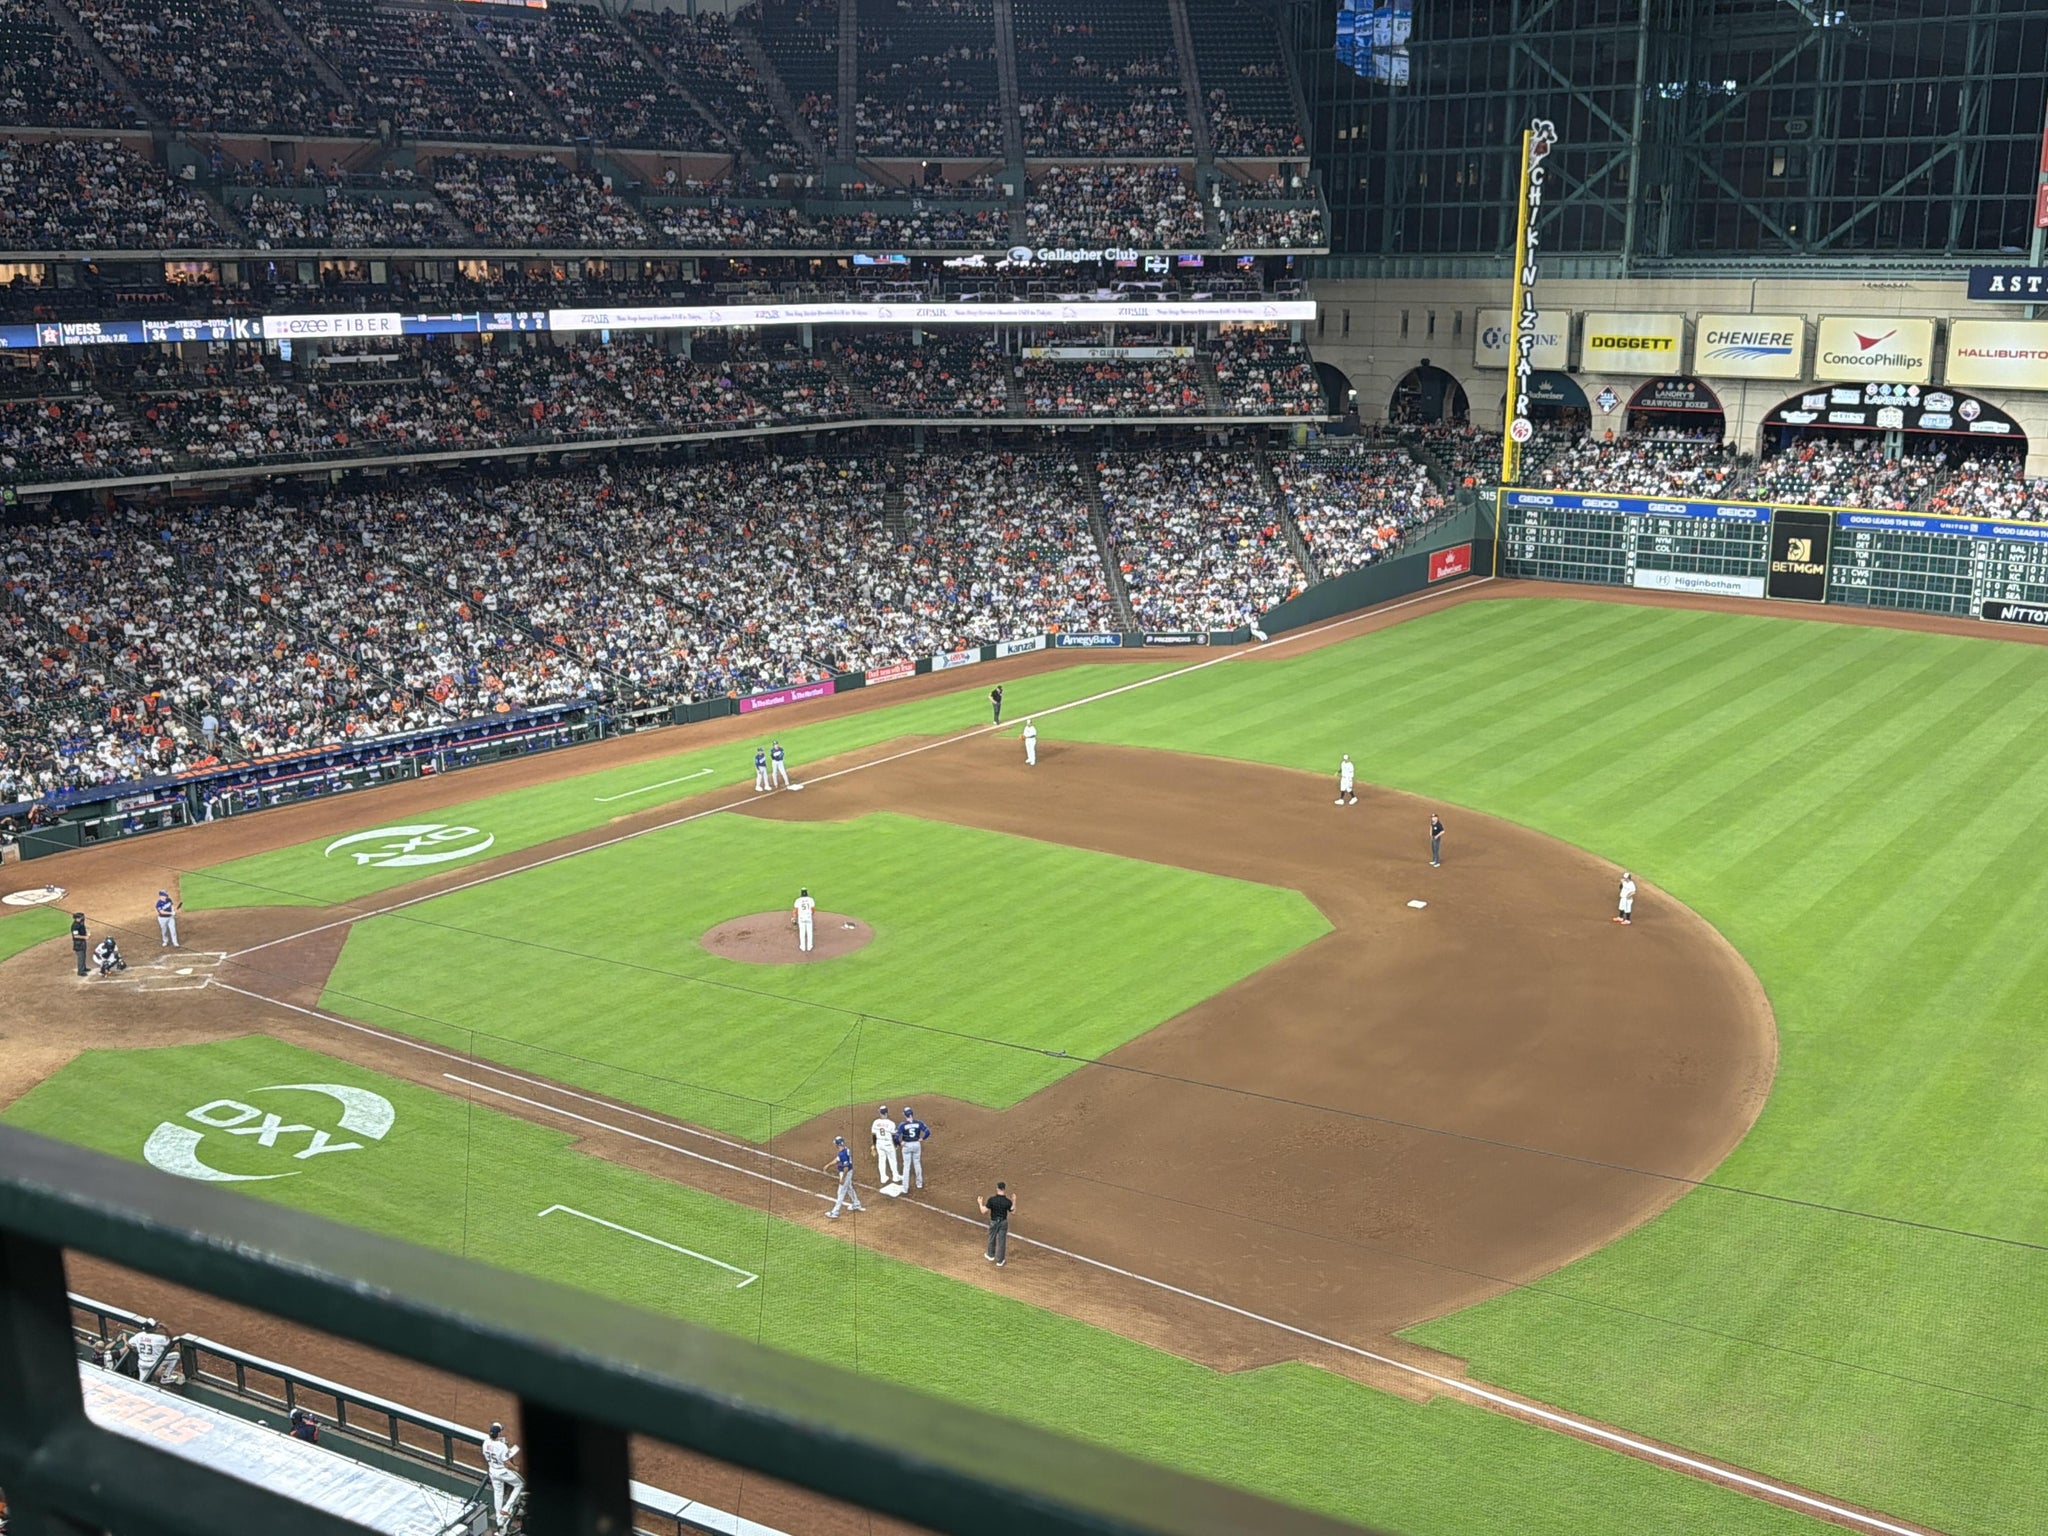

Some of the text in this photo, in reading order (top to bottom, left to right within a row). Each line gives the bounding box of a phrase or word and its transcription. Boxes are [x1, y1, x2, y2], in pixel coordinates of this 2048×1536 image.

[1521, 168, 1544, 285] CHIKIN
[1038, 248, 1138, 263] Gallagher Club
[1988, 276, 2048, 292] AST
[1520, 292, 1537, 328] IZ
[63, 323, 101, 336] WEISS
[235, 319, 250, 338] K
[290, 318, 389, 333] ezee FIBER
[183, 328, 197, 339] 53
[1706, 331, 1794, 346] CHENIERE
[1592, 338, 1672, 350] DOGGETT
[1958, 348, 2048, 360] HALLIBURTO
[1823, 352, 1922, 369] ConocoPhillips
[1517, 335, 1534, 416] FAIR
[1641, 399, 1708, 408] CRAWFORD BOXES
[1479, 490, 1496, 500] 315
[1518, 495, 1554, 504] GEICO
[1582, 499, 1619, 509] GEICO
[1648, 503, 1686, 513] GEICO
[1717, 507, 1757, 518] GEICO
[1993, 527, 2016, 535] GOOD
[2016, 528, 2040, 537] LEADS
[1626, 518, 1637, 582] NATIONAL
[1655, 544, 1670, 552] COL
[2010, 545, 2026, 554] BAL
[2008, 554, 2026, 562] NYY
[1772, 561, 1824, 575] BETMGM
[1851, 569, 1870, 578] CWS
[2008, 564, 2024, 572] CLE
[1675, 576, 1741, 590] Higginbotham
[1852, 577, 1867, 586] LAA
[1972, 544, 1986, 614] AMERICAN
[2006, 584, 2021, 592] ATL
[2006, 592, 2020, 600] SEA
[1062, 635, 1113, 646] AmegyBank
[351, 826, 480, 865] OXY
[185, 1099, 364, 1160] OXY
[909, 1128, 916, 1138] 5
[139, 1343, 153, 1355] 23
